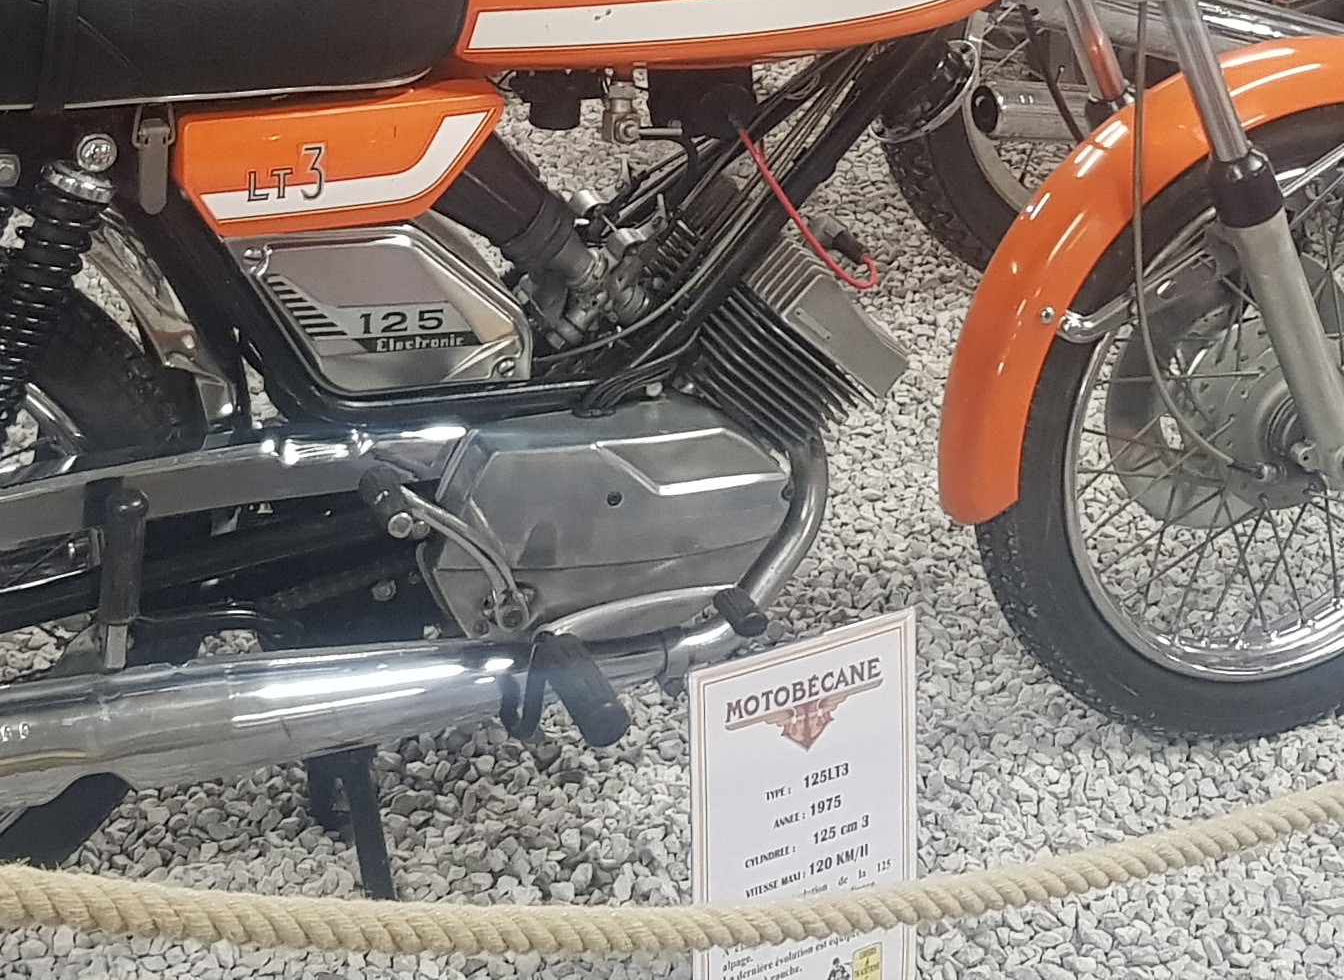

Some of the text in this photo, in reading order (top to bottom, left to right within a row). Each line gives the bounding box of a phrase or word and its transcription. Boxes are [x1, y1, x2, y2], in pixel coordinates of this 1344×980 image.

[359, 309, 444, 334] 125
[376, 335, 464, 352] Electronic
[725, 657, 882, 723] MOTOBÉCANE
[765, 786, 787, 801] TYPE
[803, 762, 849, 788] 125LT3
[810, 795, 841, 816] 1975
[813, 826, 836, 845] 125
[840, 821, 858, 836] cm
[861, 815, 869, 828] 3
[745, 879, 778, 898] VITESSE
[781, 871, 801, 886] MAXI
[809, 856, 833, 875] 120
[836, 843, 869, 867] KM/H
[858, 869, 866, 879] la
[877, 859, 891, 872] 125
[815, 939, 827, 951] est
